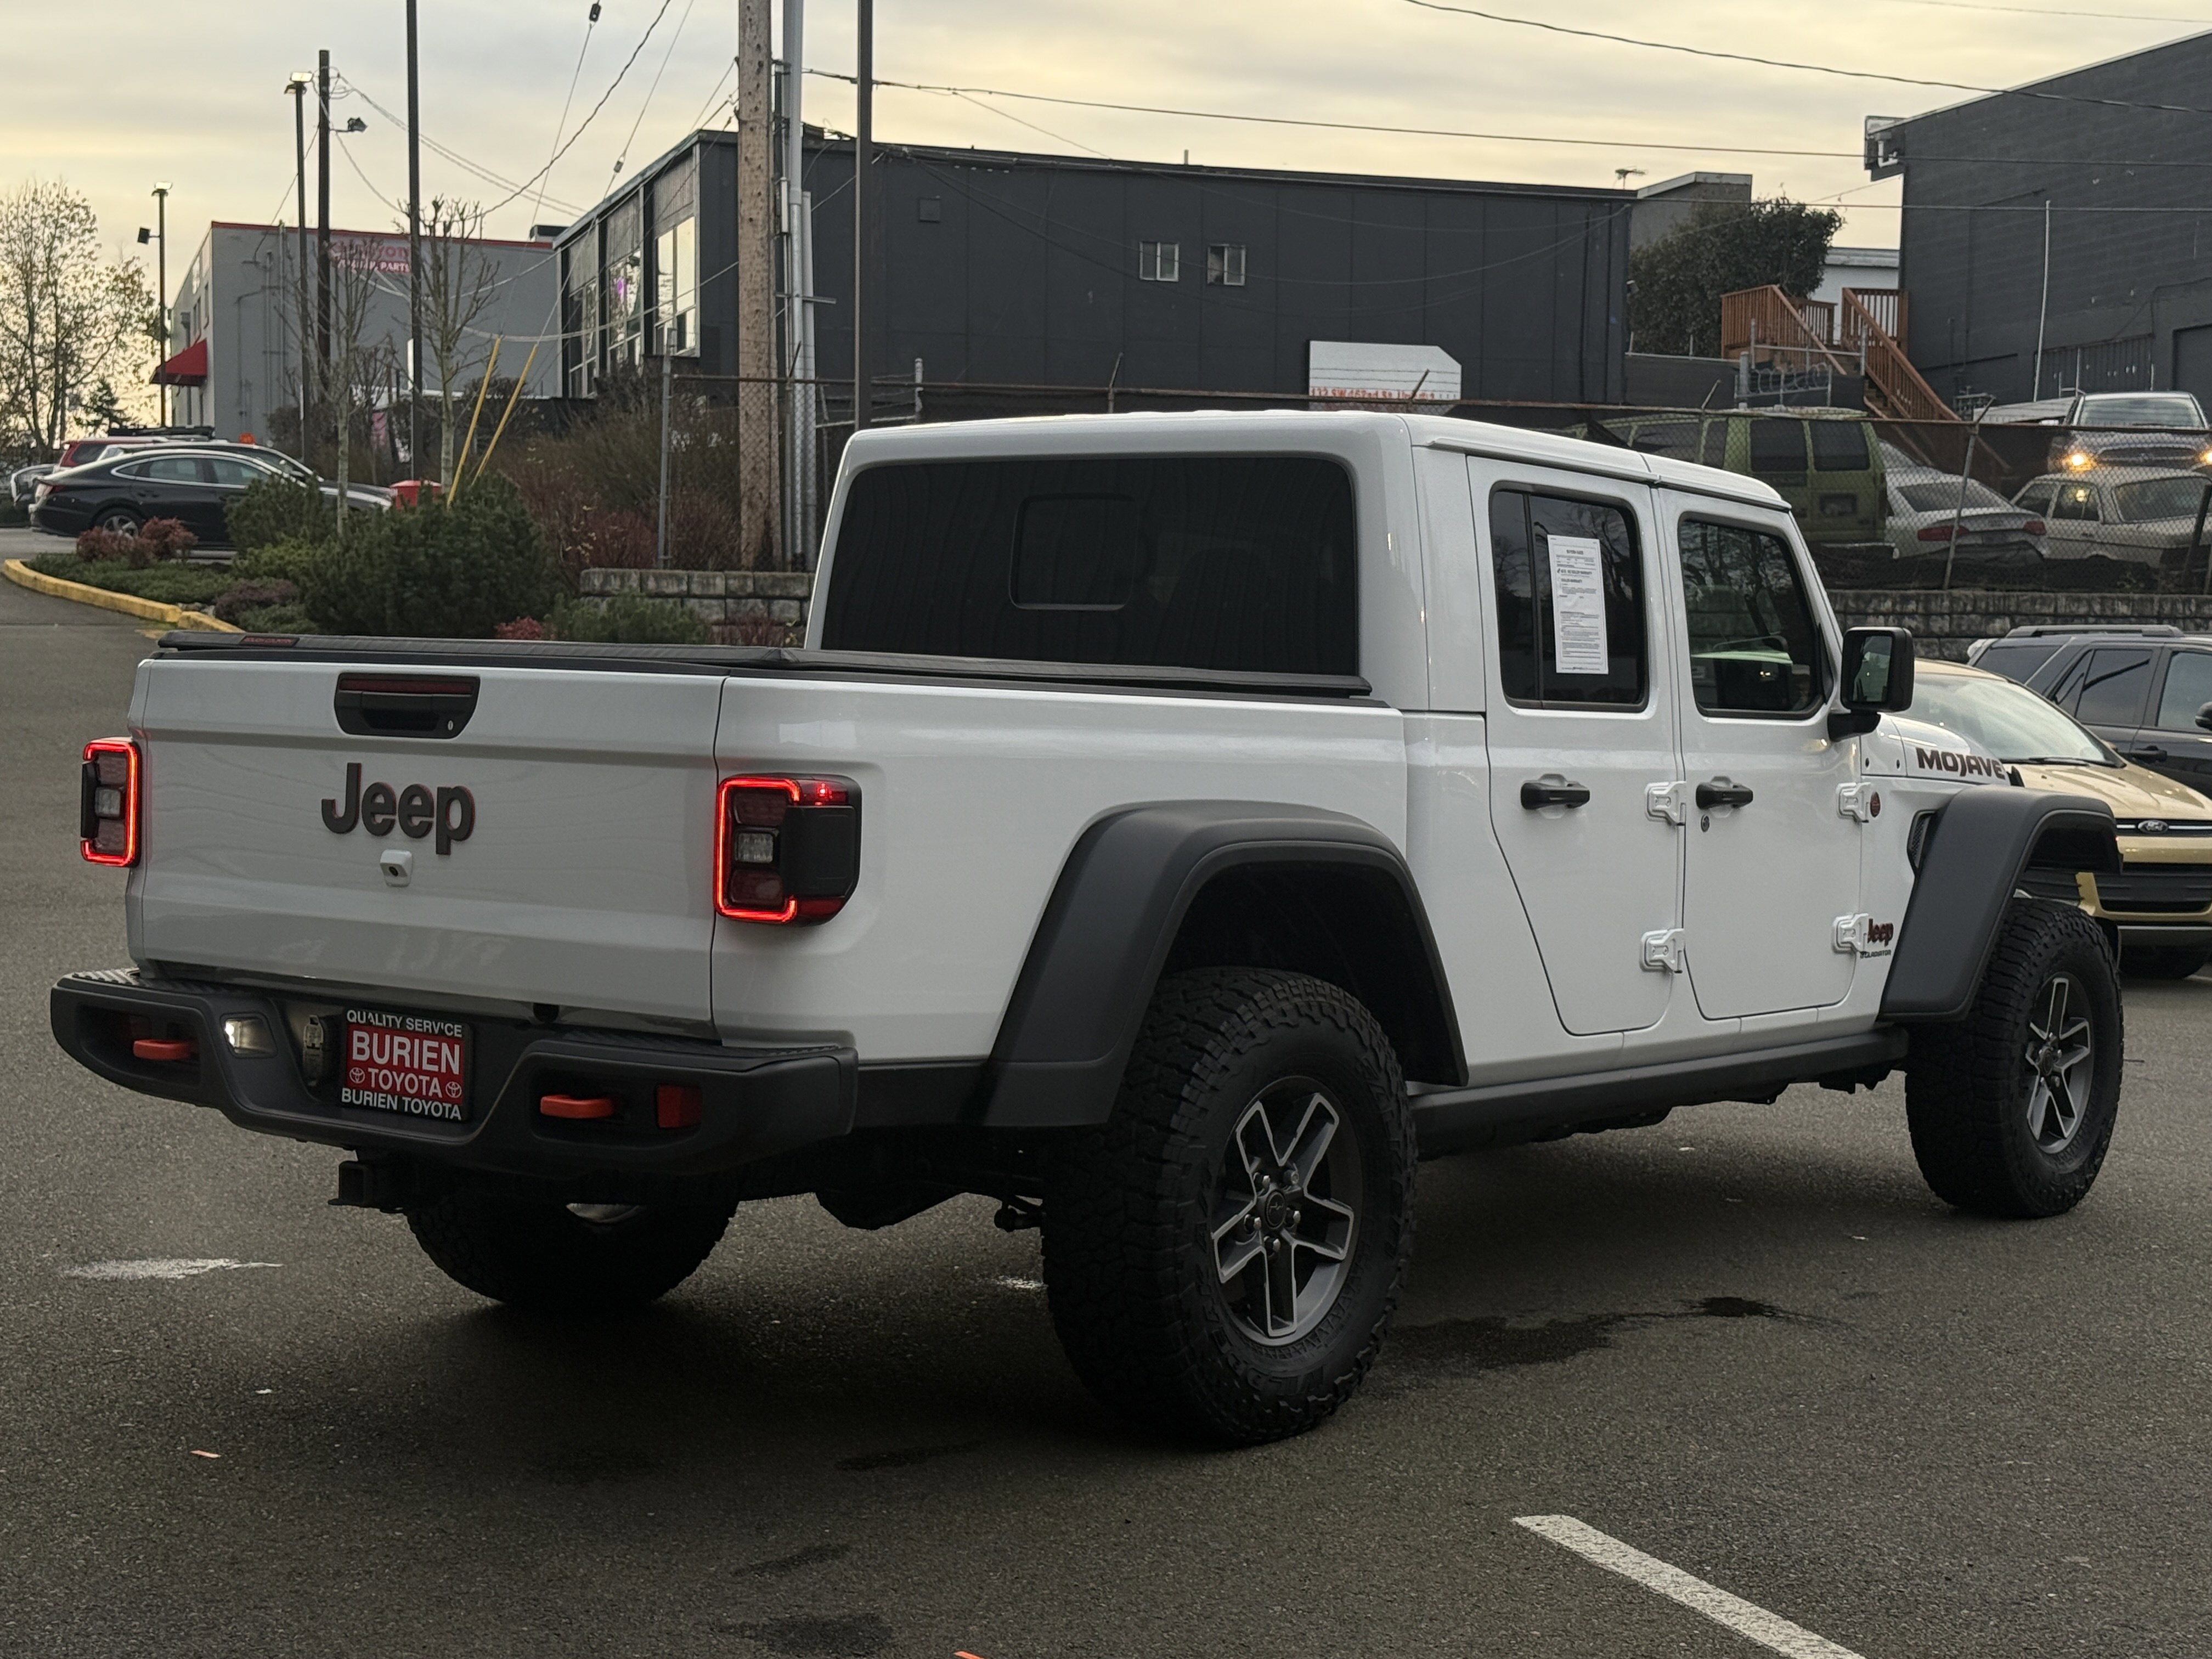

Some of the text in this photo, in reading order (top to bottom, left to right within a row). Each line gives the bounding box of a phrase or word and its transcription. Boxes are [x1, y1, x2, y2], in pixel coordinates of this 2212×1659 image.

[1916, 747, 2006, 780] MOJAVE
[321, 762, 476, 856] Jeep
[1867, 918, 1894, 946] Jeep
[347, 1009, 403, 1029] QUALITY
[353, 1030, 460, 1075] BURIEN
[368, 1068, 443, 1098] TOYOTA
[341, 1088, 462, 1121] BURIEN TOYOTA
